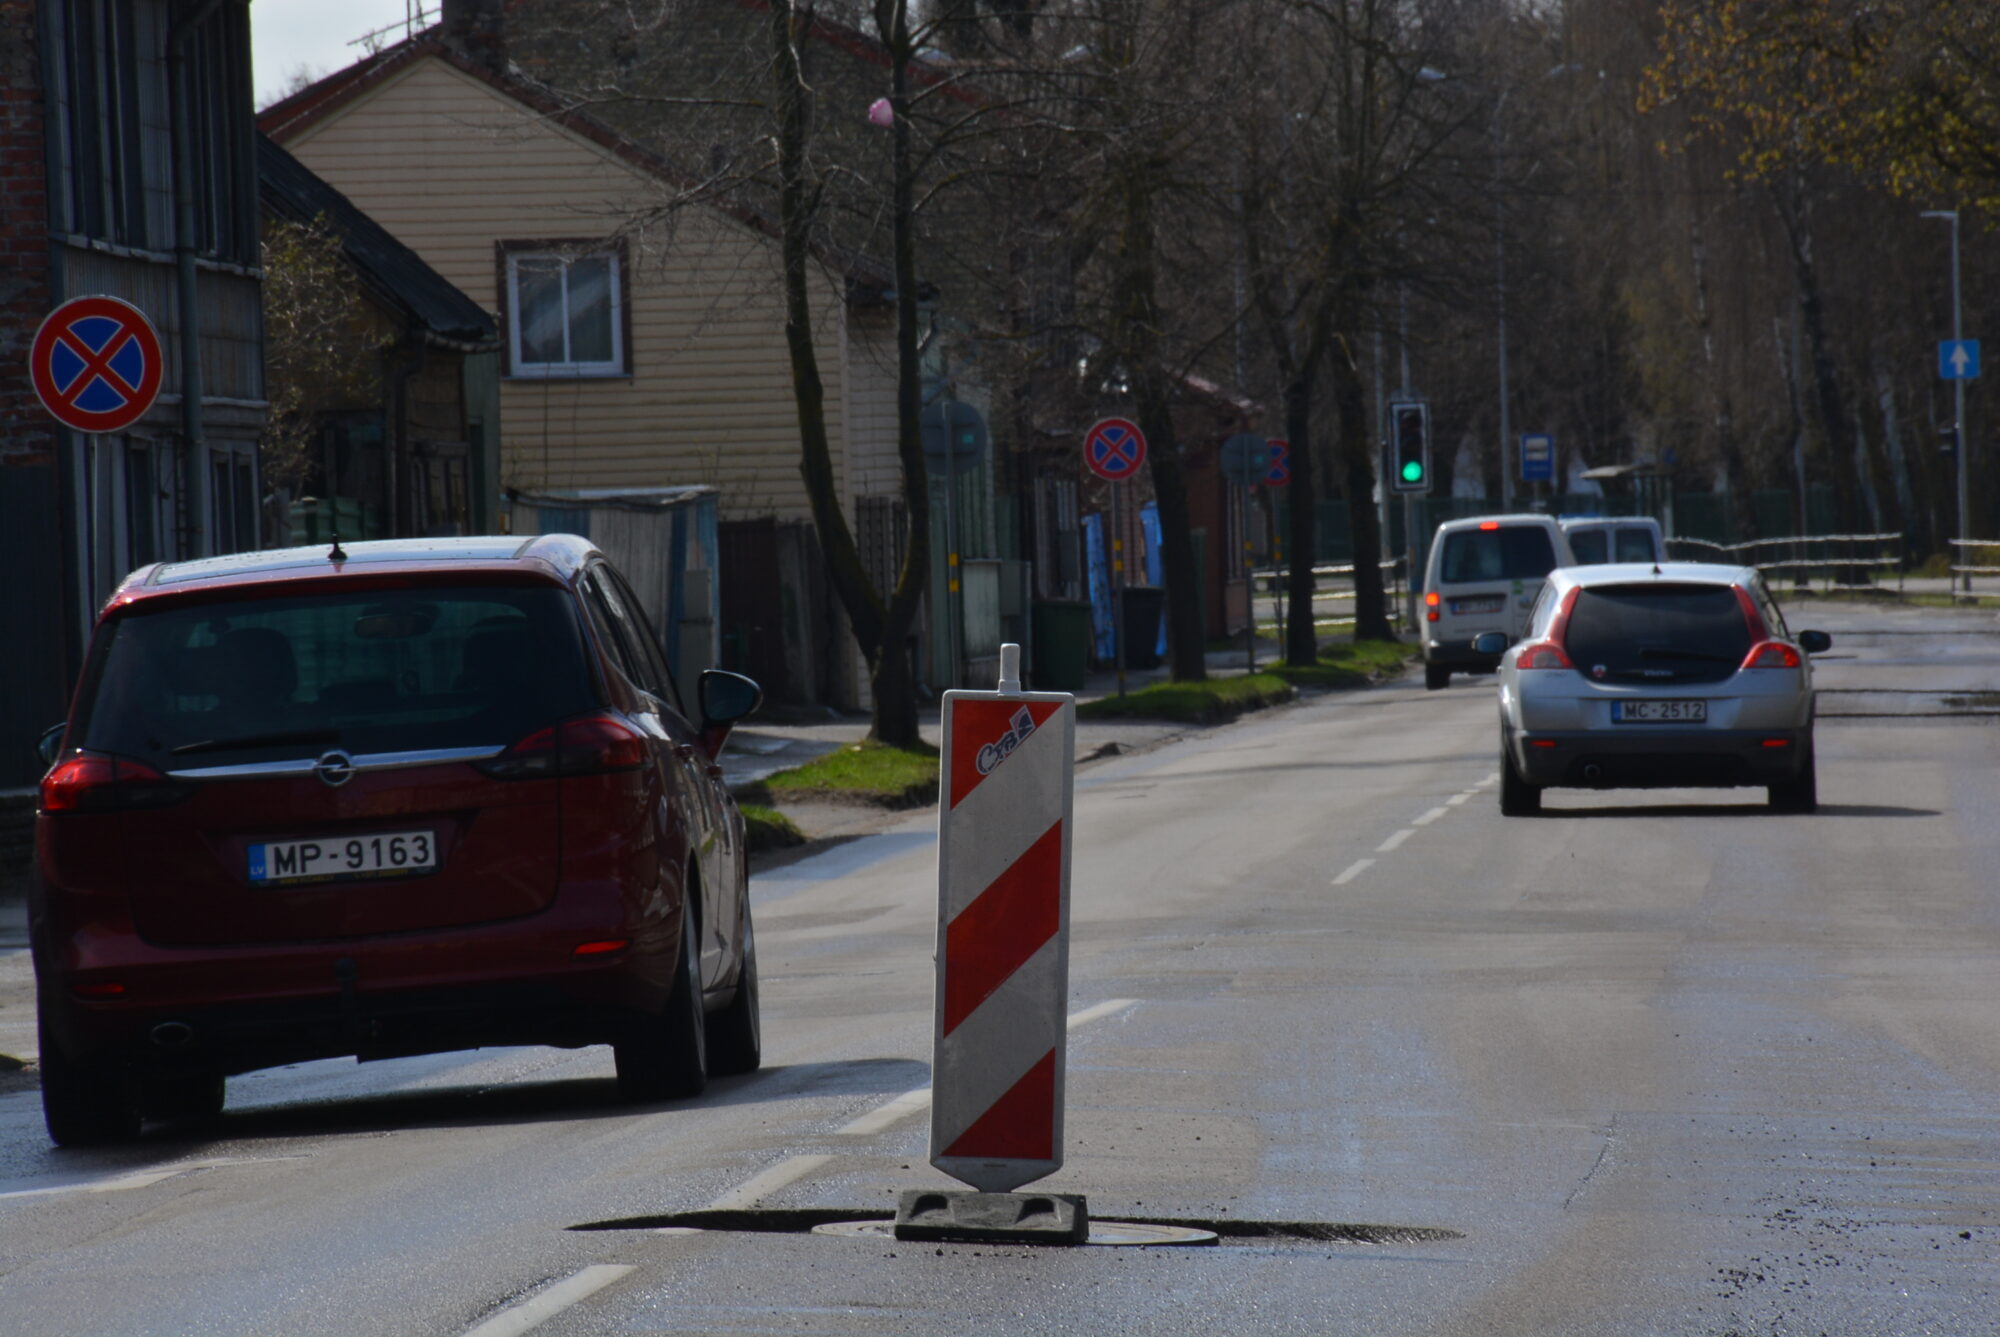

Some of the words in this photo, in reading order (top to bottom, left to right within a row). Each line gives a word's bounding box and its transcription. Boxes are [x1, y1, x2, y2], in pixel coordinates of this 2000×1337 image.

[1626, 703, 1702, 718] MC-2512
[250, 866, 265, 875] LV
[275, 835, 430, 876] MP-9163
